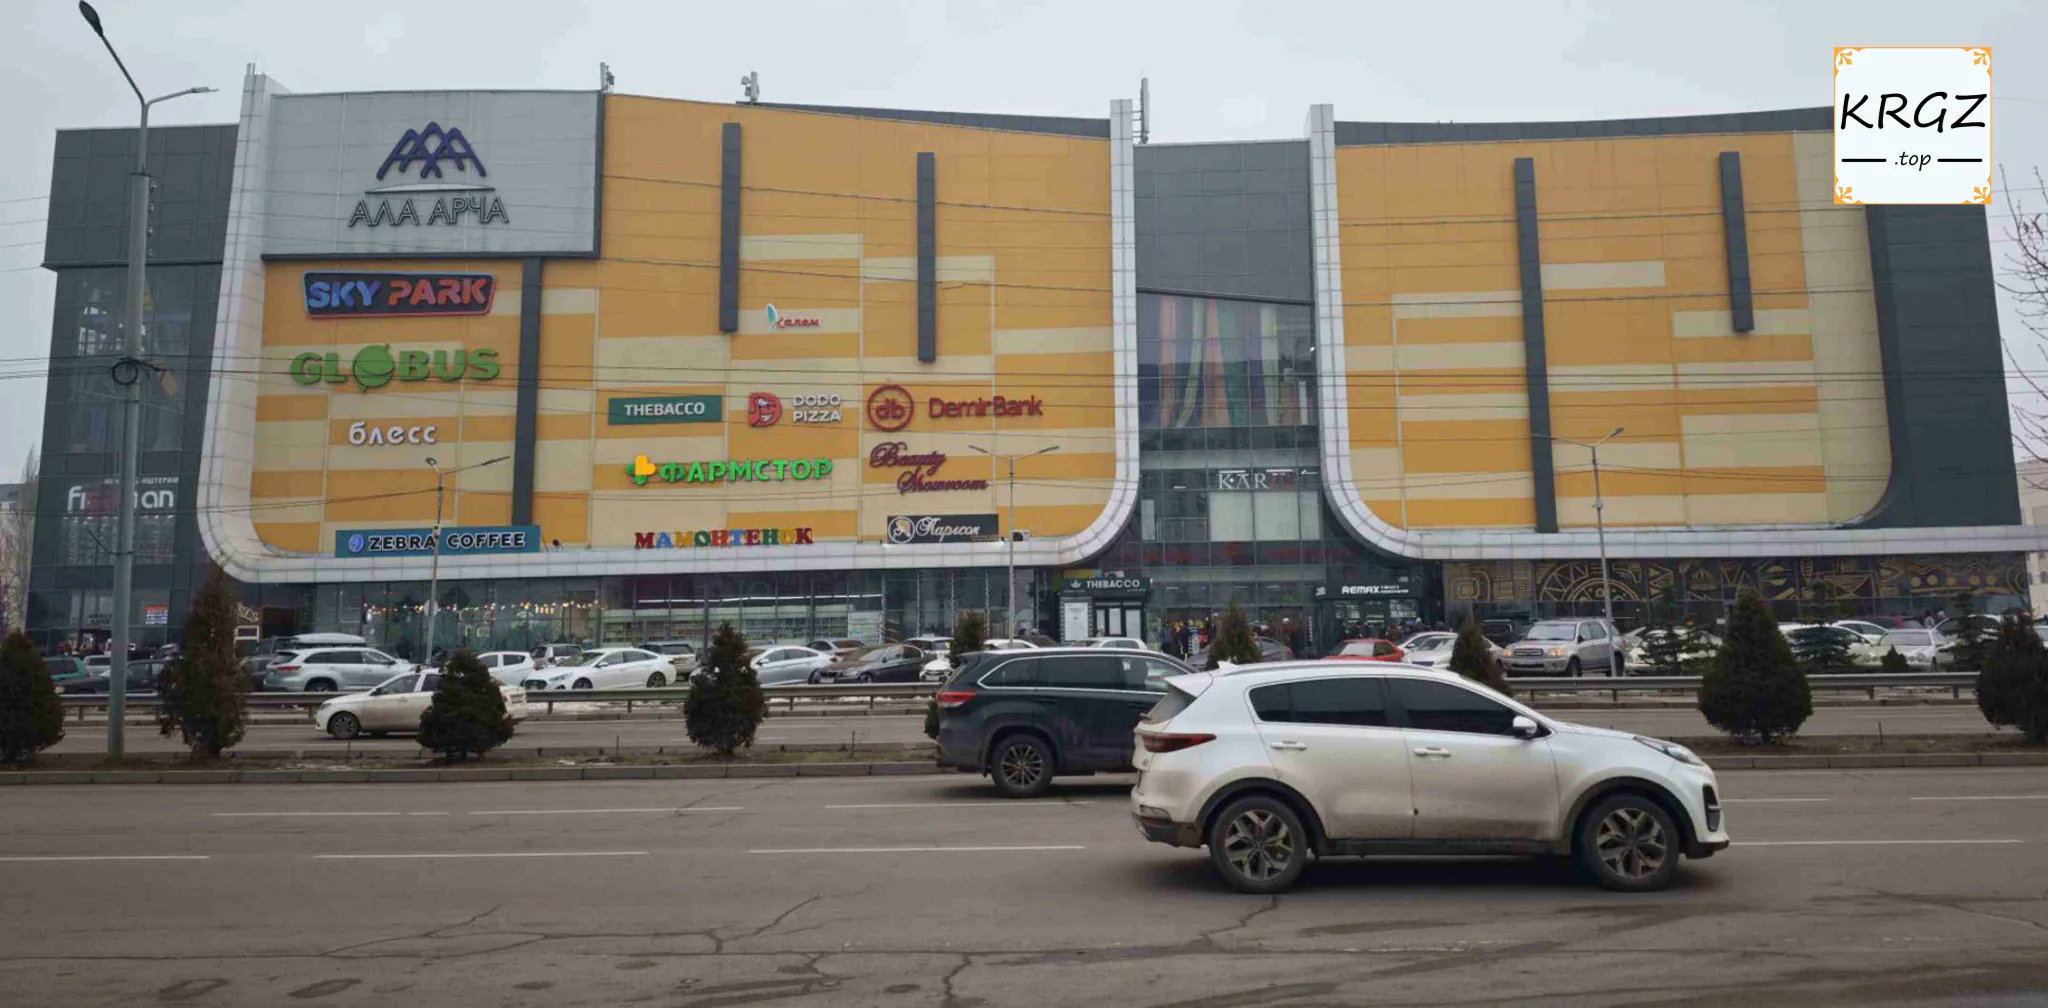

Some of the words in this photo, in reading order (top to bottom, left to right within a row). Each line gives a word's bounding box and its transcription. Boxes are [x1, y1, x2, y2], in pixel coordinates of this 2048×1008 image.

[348, 198, 420, 227] АЛА
[427, 196, 509, 225] АРЧА
[308, 280, 380, 308] SKY
[388, 278, 487, 306] PARK
[289, 344, 499, 393] GLOBUS
[624, 402, 705, 416] THEBACCO
[793, 394, 841, 406] DODO
[793, 410, 841, 422] PIZZA
[349, 420, 437, 446] блесс
[659, 458, 833, 484] ФАРМСТОР
[869, 441, 948, 476] Beauty
[897, 465, 989, 496] Showroom
[368, 534, 437, 551] ZEBRA
[446, 532, 526, 549] COFFEE
[1086, 579, 1141, 589] THEBACCO
[1341, 585, 1380, 594] REMAX
